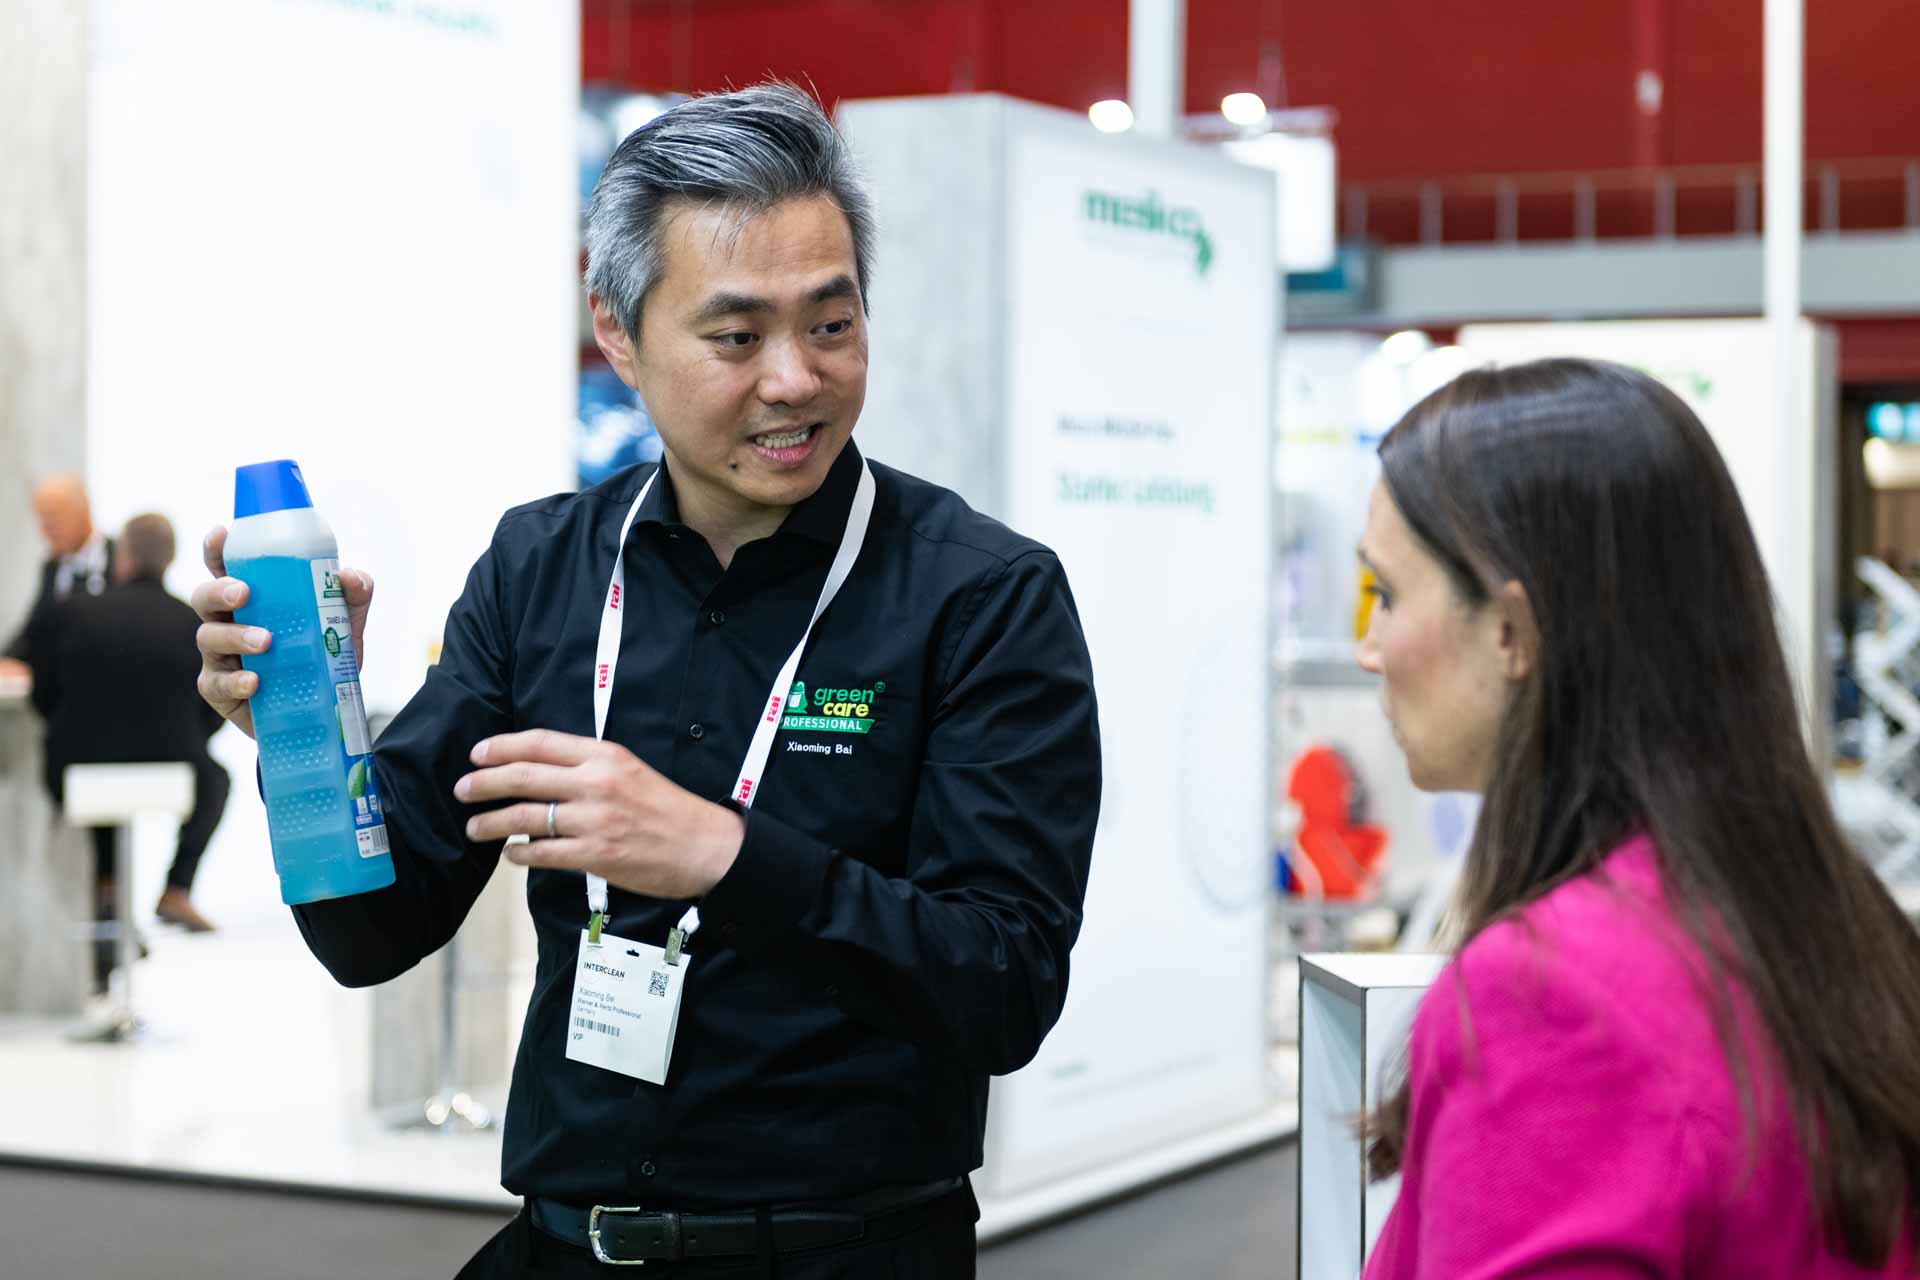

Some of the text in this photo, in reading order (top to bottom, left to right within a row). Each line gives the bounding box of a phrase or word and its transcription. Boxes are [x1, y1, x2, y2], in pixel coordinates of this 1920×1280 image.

[813, 687, 875, 706] green
[823, 702, 870, 717] care
[781, 716, 863, 731] ROFESSIONAL
[787, 741, 853, 755] Xiaoming Bai
[583, 961, 626, 979] INTERCLEAN
[572, 1031, 584, 1041] VIP
